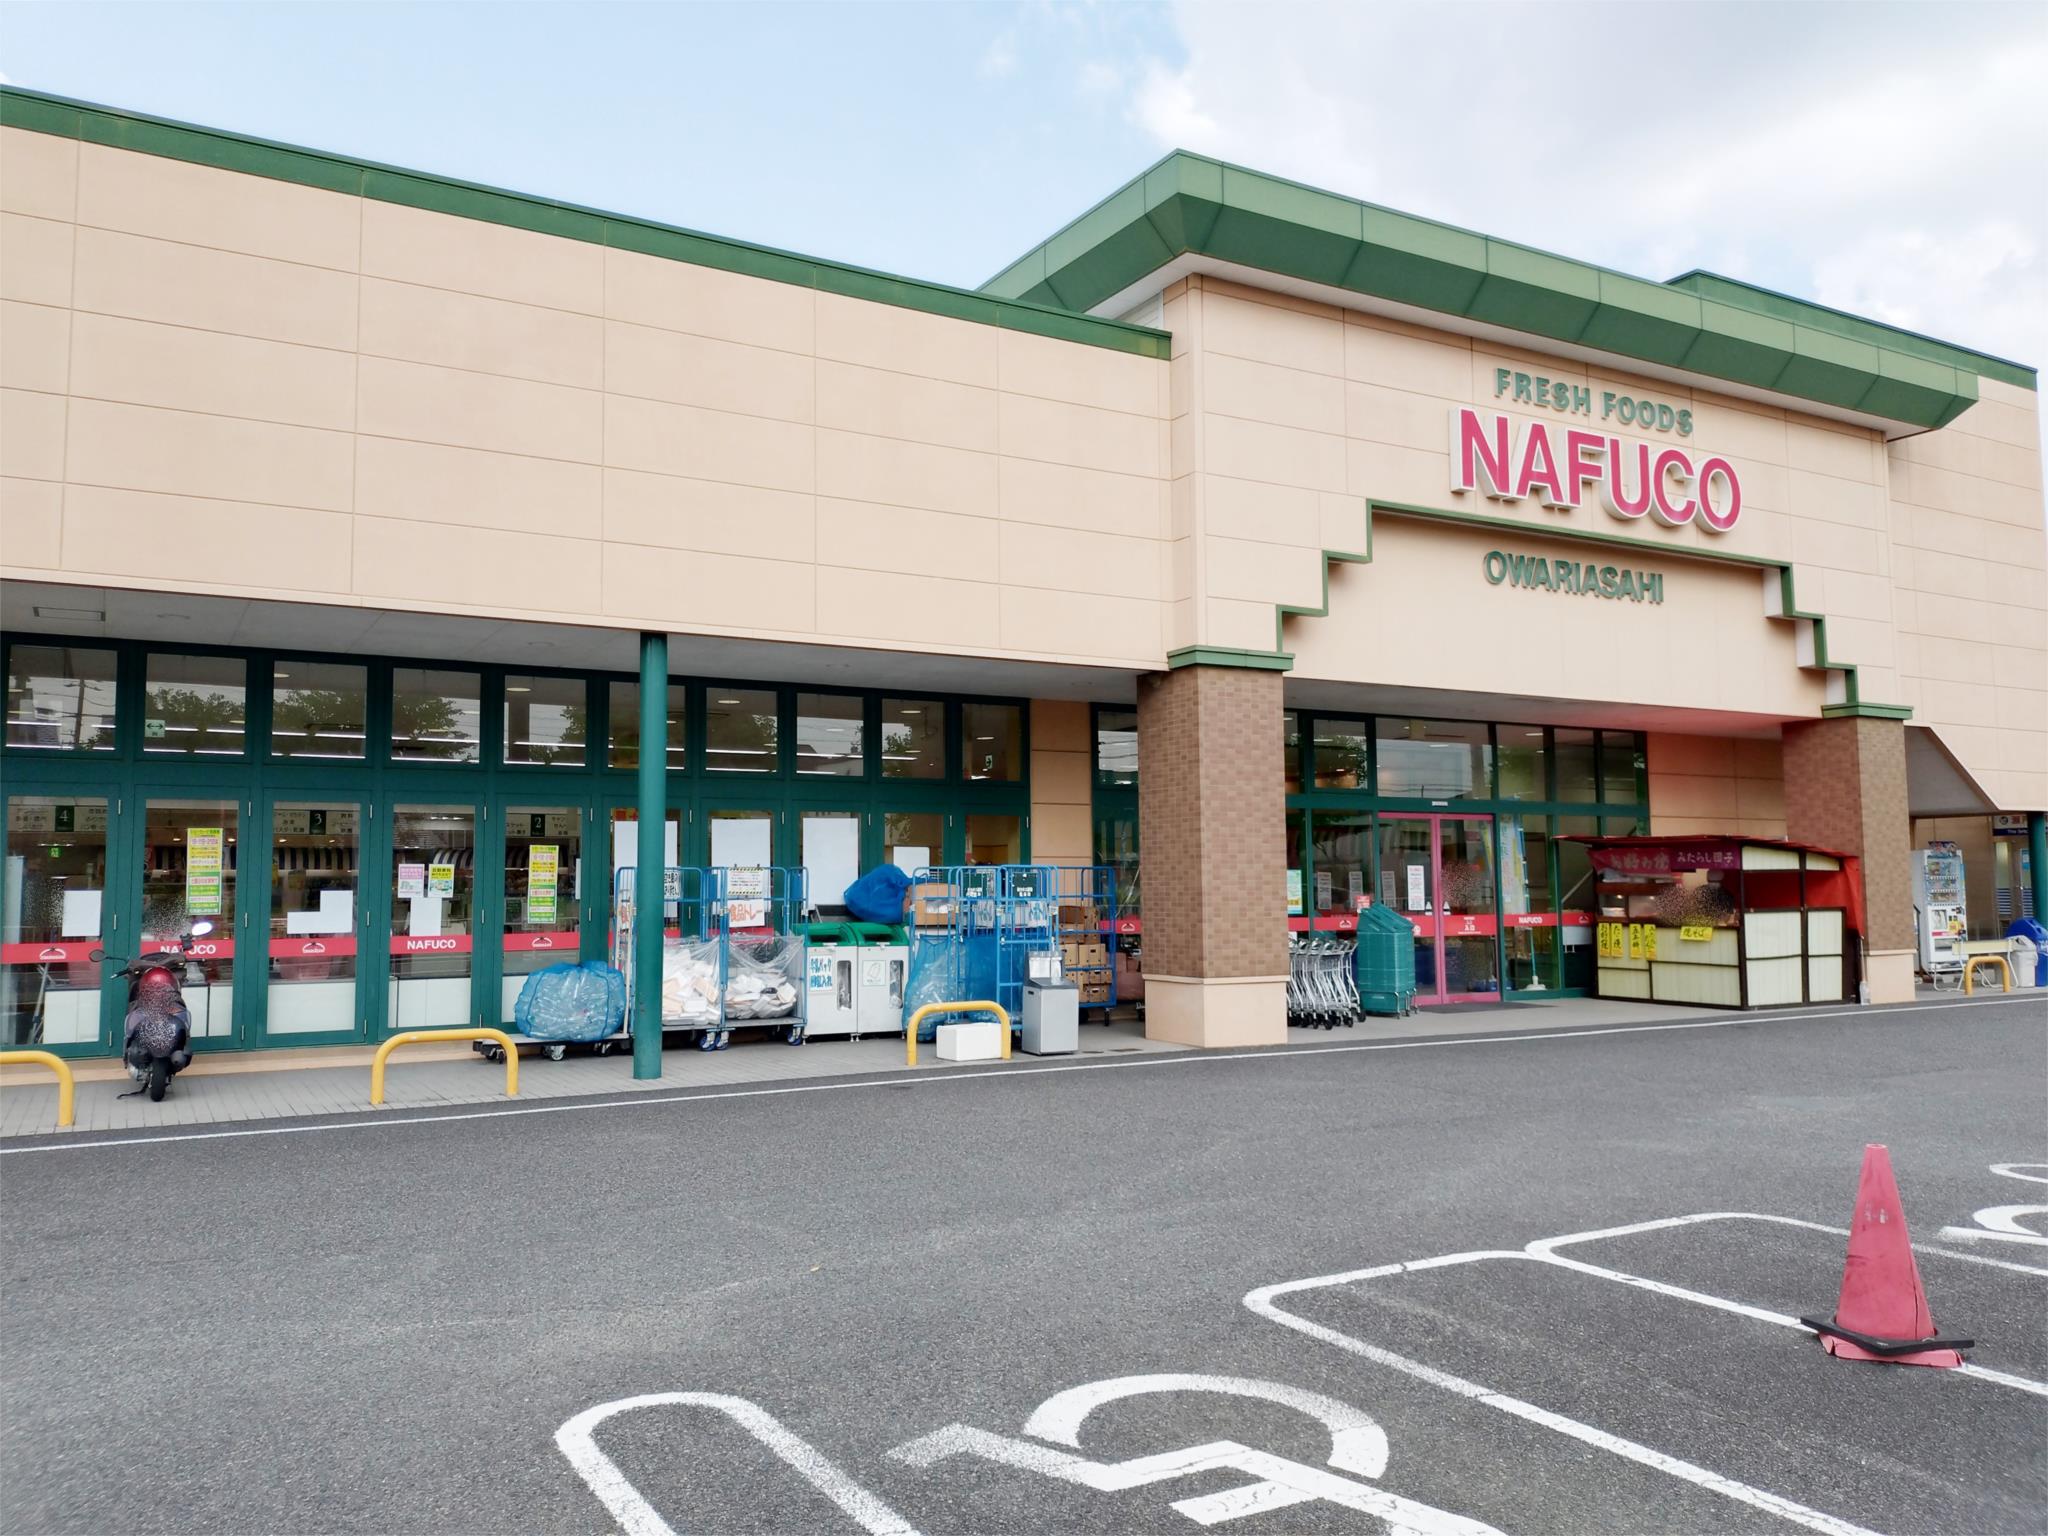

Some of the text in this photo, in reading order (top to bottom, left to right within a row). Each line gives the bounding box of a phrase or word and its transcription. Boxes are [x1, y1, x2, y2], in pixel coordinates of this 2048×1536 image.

[1494, 367, 1694, 437] FRESH FOODS
[1450, 406, 1742, 534] NAFUCO
[1483, 550, 1665, 604] OWARIASAHI
[314, 813, 323, 825] 3
[534, 816, 543, 828] 2
[1518, 916, 1543, 924] NAFUCO
[160, 944, 216, 956] NAUCO
[406, 939, 457, 951] NAFUCO
